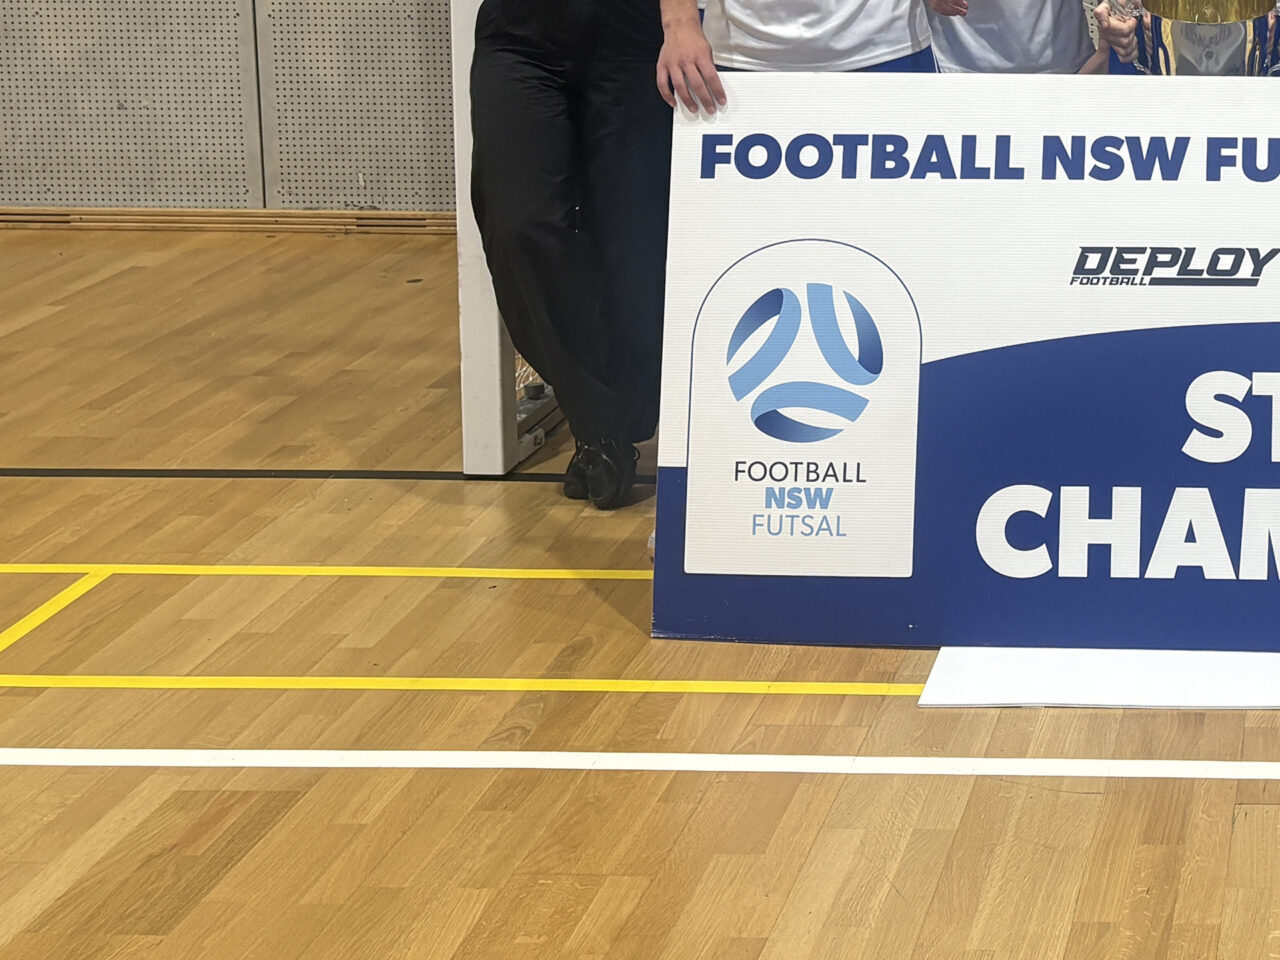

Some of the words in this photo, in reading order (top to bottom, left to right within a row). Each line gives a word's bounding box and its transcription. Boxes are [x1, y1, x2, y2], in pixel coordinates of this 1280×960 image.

[699, 132, 1025, 180] FOOTBALL
[1041, 135, 1191, 182] NSW
[1069, 276, 1147, 286] FOOTBALL
[734, 460, 867, 483] FOOTBALL
[764, 486, 835, 510] NSW
[752, 514, 847, 537] FUTSAL
